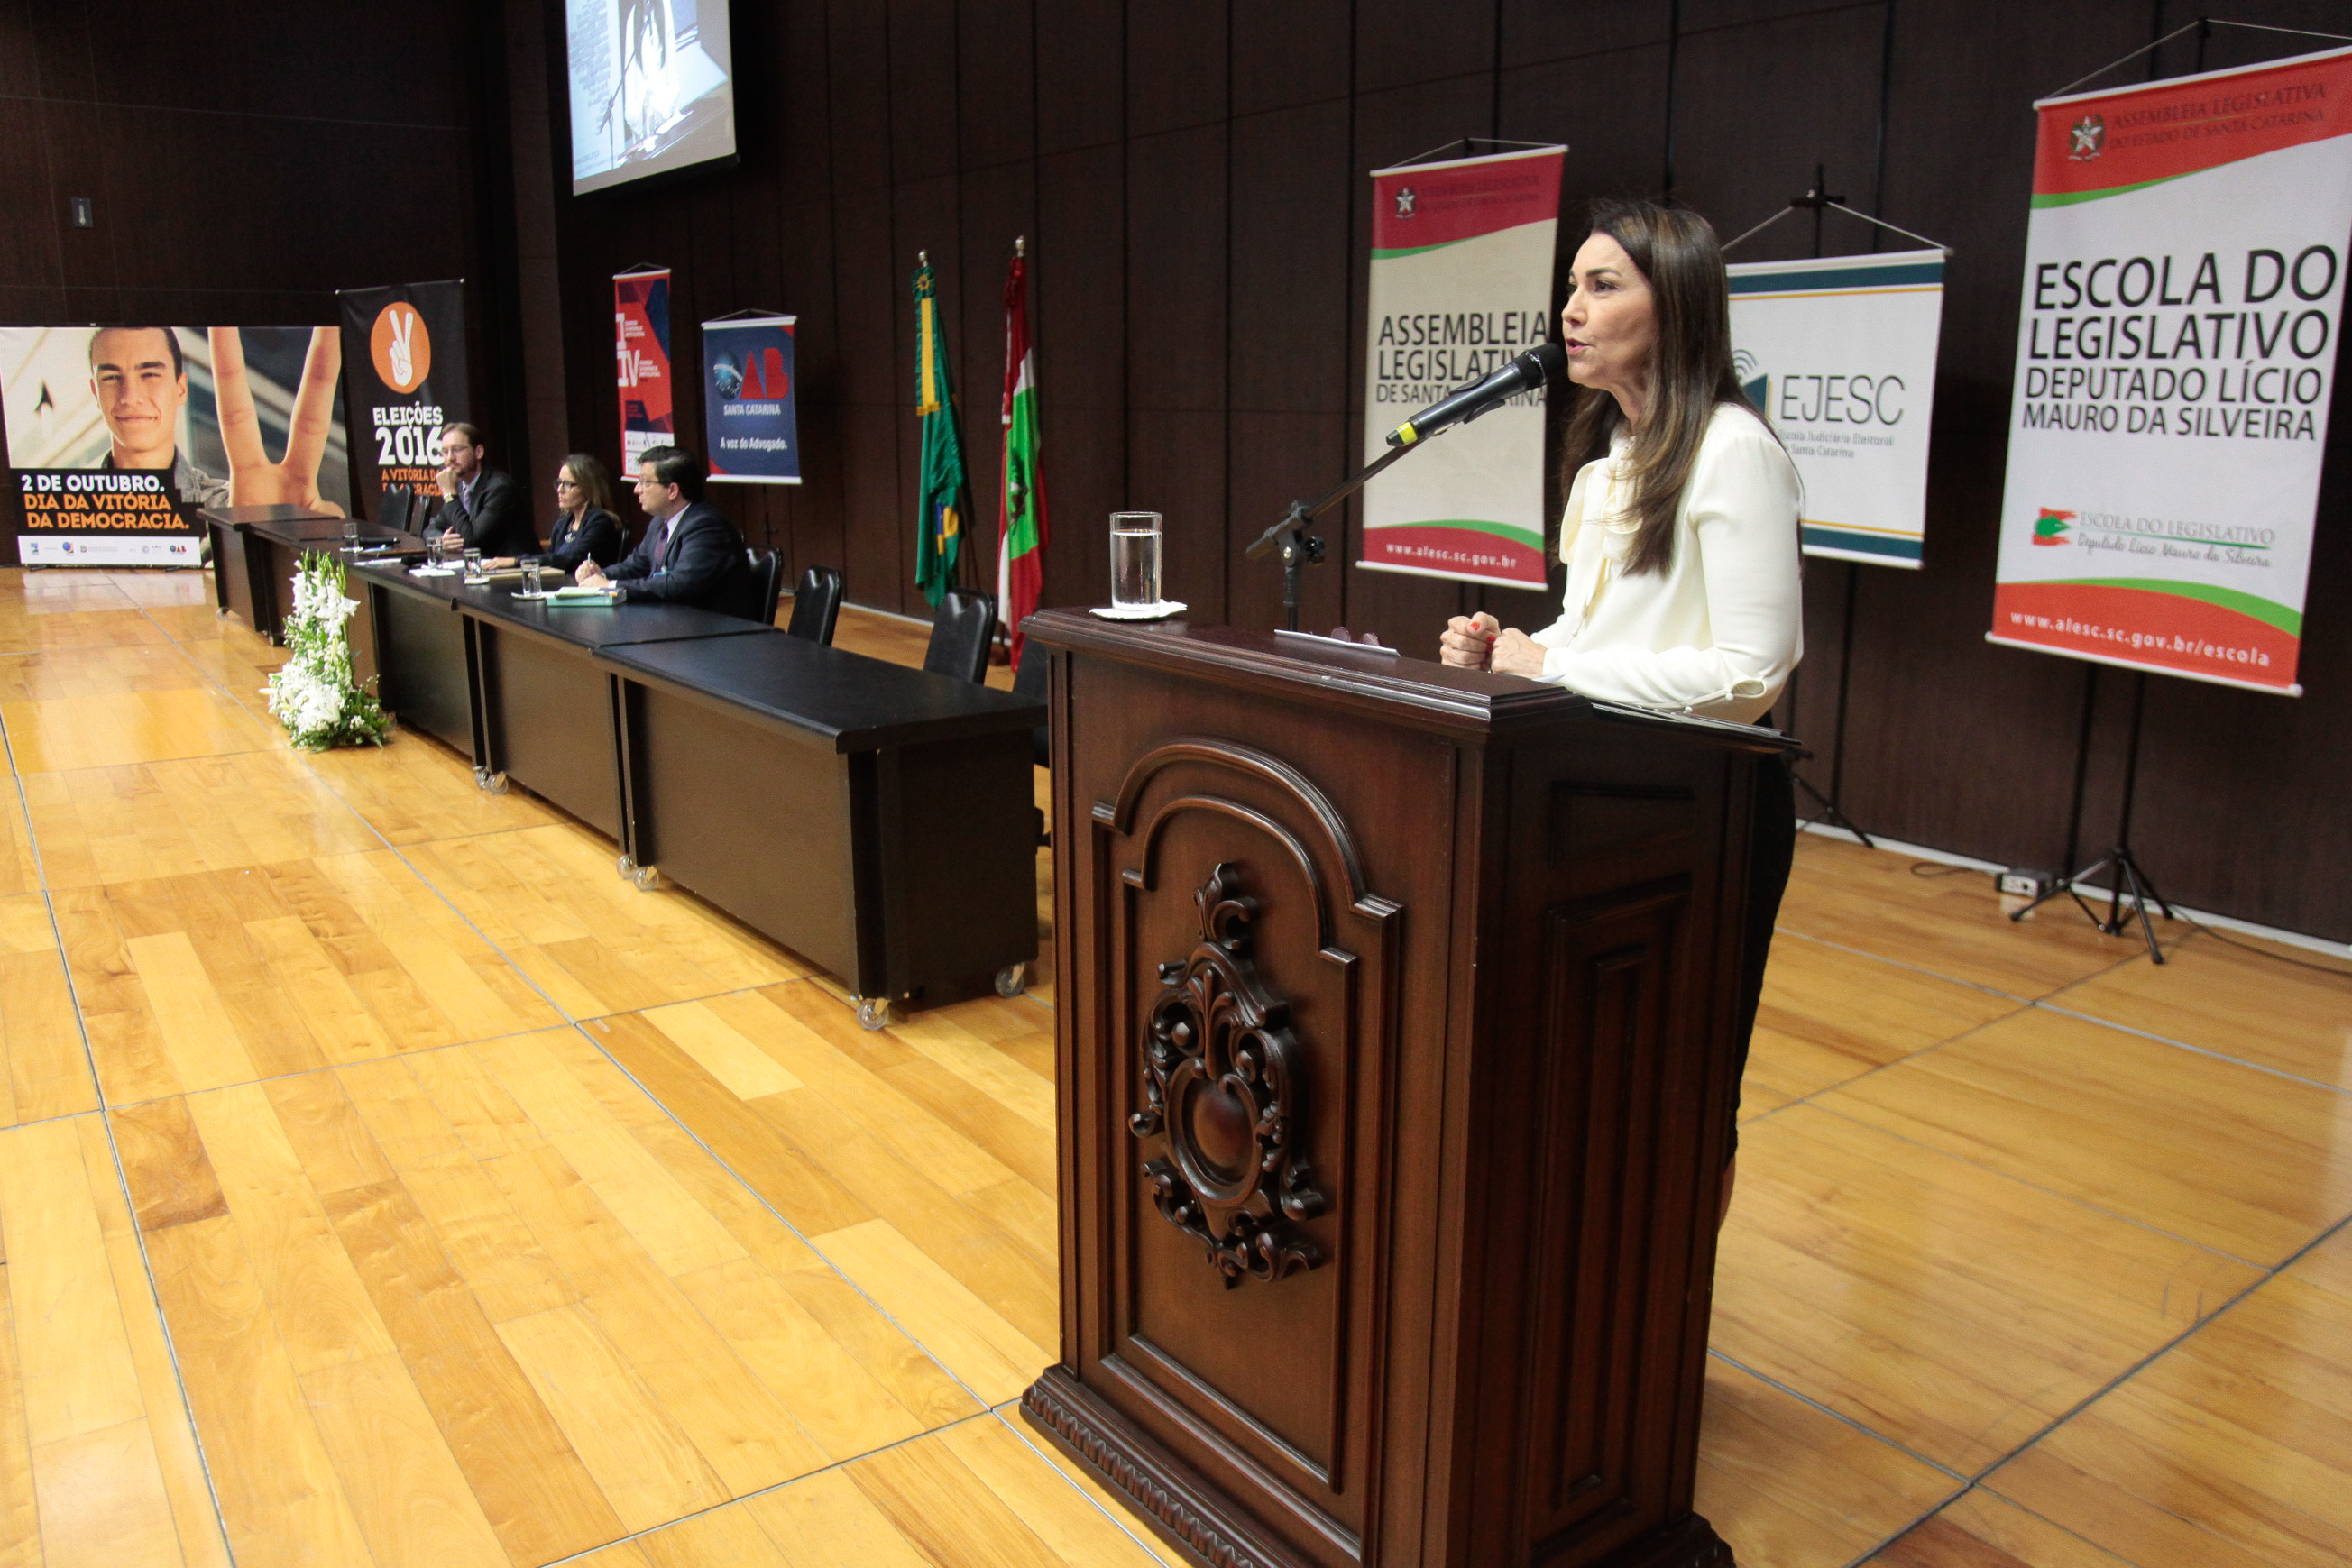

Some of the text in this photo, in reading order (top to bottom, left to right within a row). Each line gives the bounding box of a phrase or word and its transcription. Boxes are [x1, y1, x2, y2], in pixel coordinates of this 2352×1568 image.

[2213, 83, 2327, 115] LEGISLATIVA
[2034, 245, 2338, 310] ESCOLA DO
[1378, 312, 1548, 345] ASSEMBLEIA
[2029, 309, 2329, 360] LEGISLATIVO
[1377, 383, 1396, 403] DE
[2026, 359, 2322, 405] DEPUTADO LÍCIO
[372, 401, 444, 429] ELEIÇÕES
[723, 403, 781, 416] SANTA CATARINA
[1780, 374, 1906, 426] EJESC
[2023, 403, 2315, 441] MAURO DA SILVEIRA
[375, 426, 446, 466] 2016
[720, 436, 726, 449] A
[21, 474, 165, 492] 2 DE OUTUBRO.
[381, 468, 390, 481] A
[390, 465, 429, 481] VITÓRIA
[24, 491, 171, 510] DIA DA VITÓRIA
[26, 512, 189, 529] DA DEMOCRACIA.
[2080, 511, 2276, 545] ESCOLA DO LEGISLATIVO
[1386, 542, 1517, 568] www.alesc.sc.gov.br
[2010, 611, 2271, 667] www.alesc.sc.gov.br/escola
